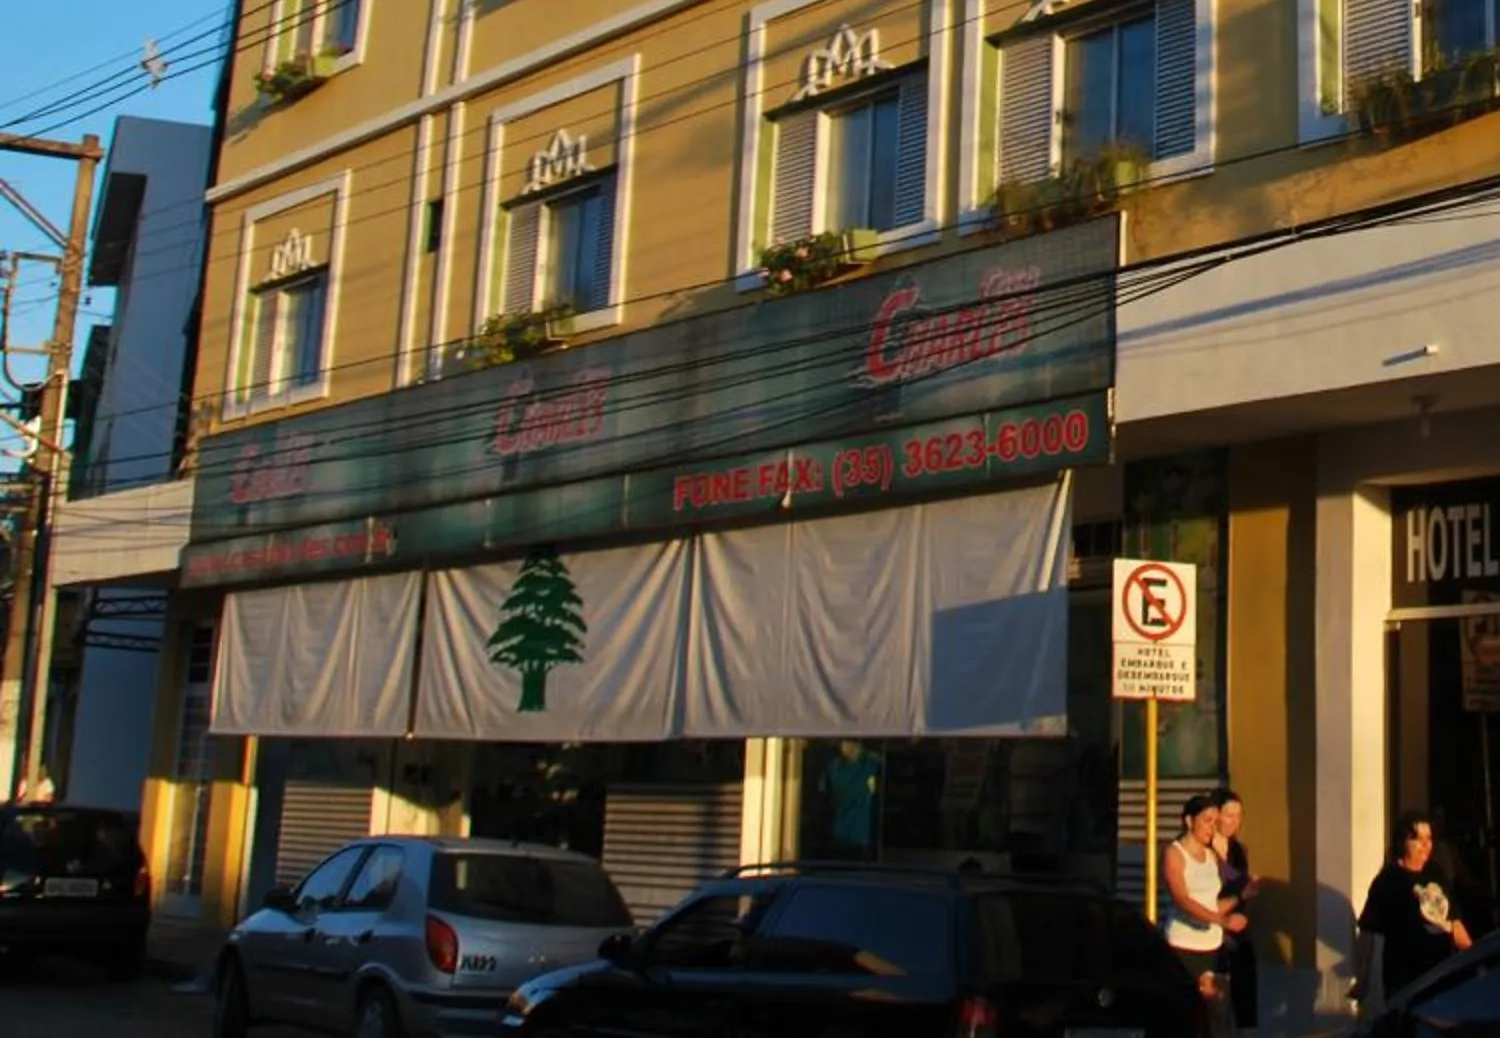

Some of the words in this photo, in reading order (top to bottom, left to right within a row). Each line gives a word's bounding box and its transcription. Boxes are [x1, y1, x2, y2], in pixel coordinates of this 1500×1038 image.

[831, 444, 893, 499] (35)
[902, 409, 1089, 479] 3623-6000
[1406, 503, 1499, 583] HOTEL
[1137, 647, 1171, 657] HOTEL
